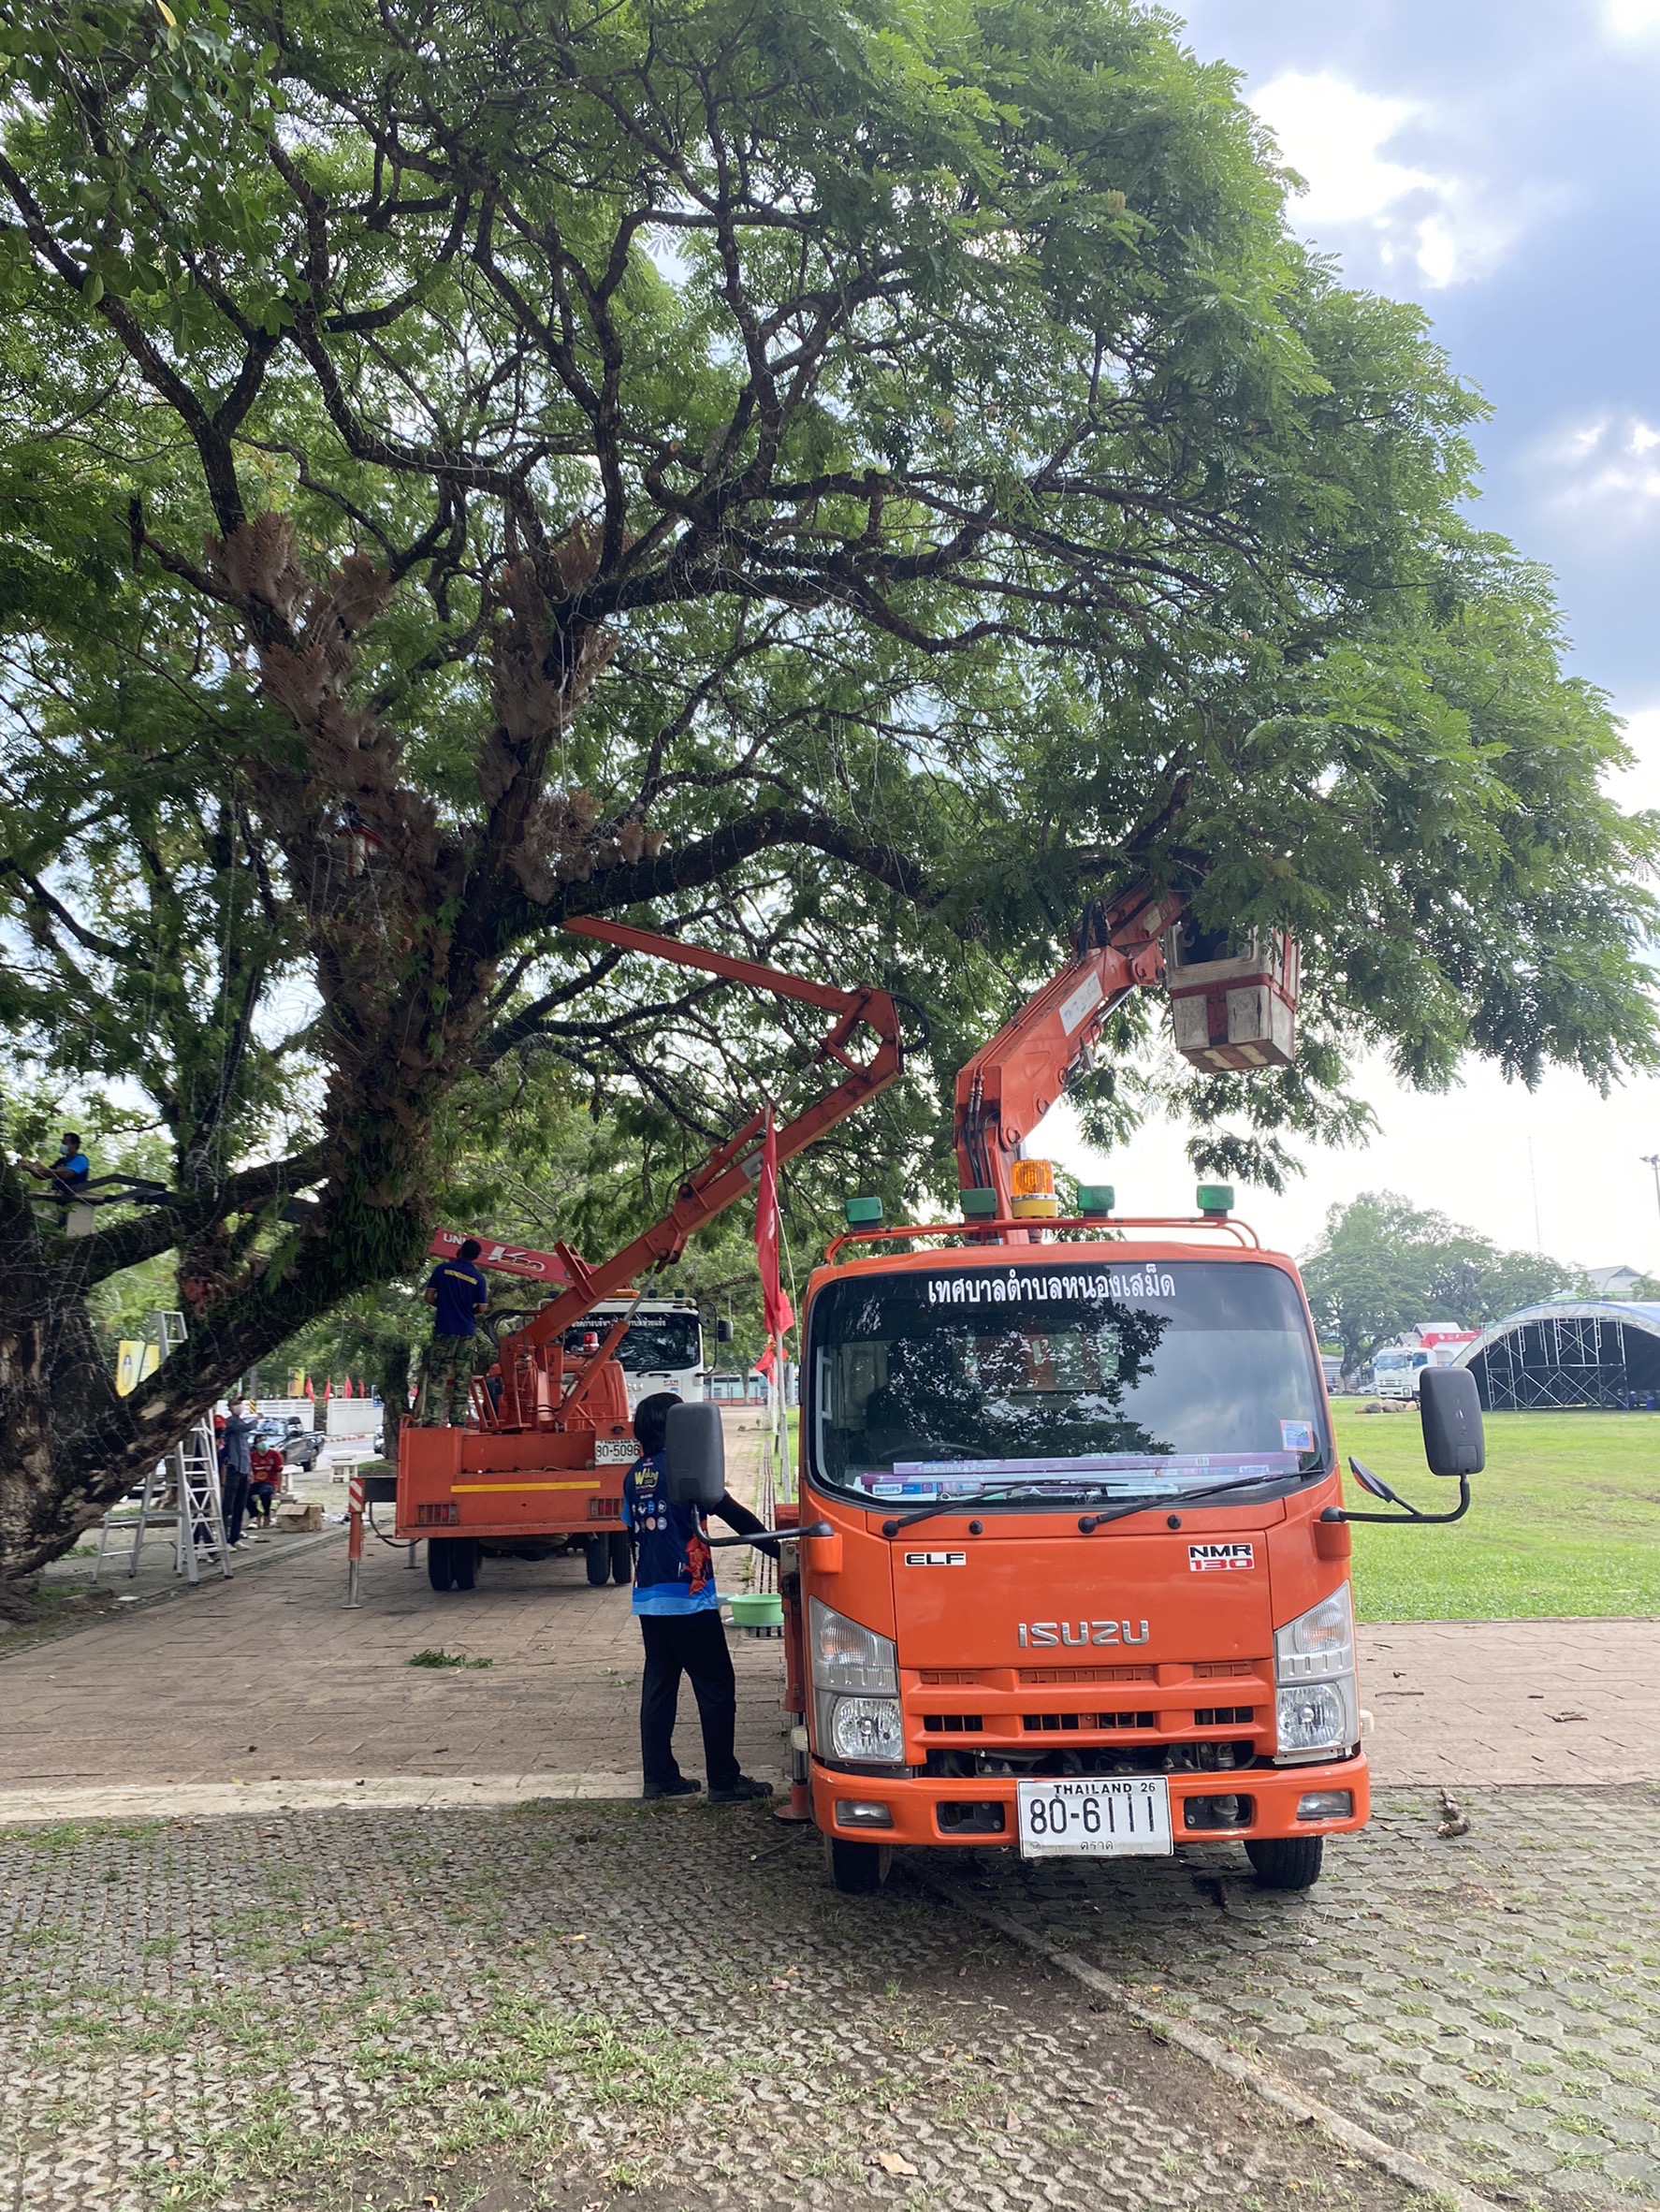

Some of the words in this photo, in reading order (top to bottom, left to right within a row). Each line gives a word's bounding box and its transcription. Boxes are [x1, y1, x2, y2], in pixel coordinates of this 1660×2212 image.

[928, 1263, 1176, 1303] เทศบาลตำบลหนองเสม็ด
[596, 1444, 641, 1458] 80-5096
[1189, 1543, 1252, 1558] NMR
[906, 1553, 966, 1565] ELF
[1190, 1558, 1253, 1571] 130
[1018, 1620, 1150, 1648] ISUZU
[1054, 1783, 1132, 1796] THAILAND
[1141, 1782, 1156, 1793] 26
[1030, 1796, 1155, 1835] 80-6111
[1080, 1840, 1114, 1851] ตราด
